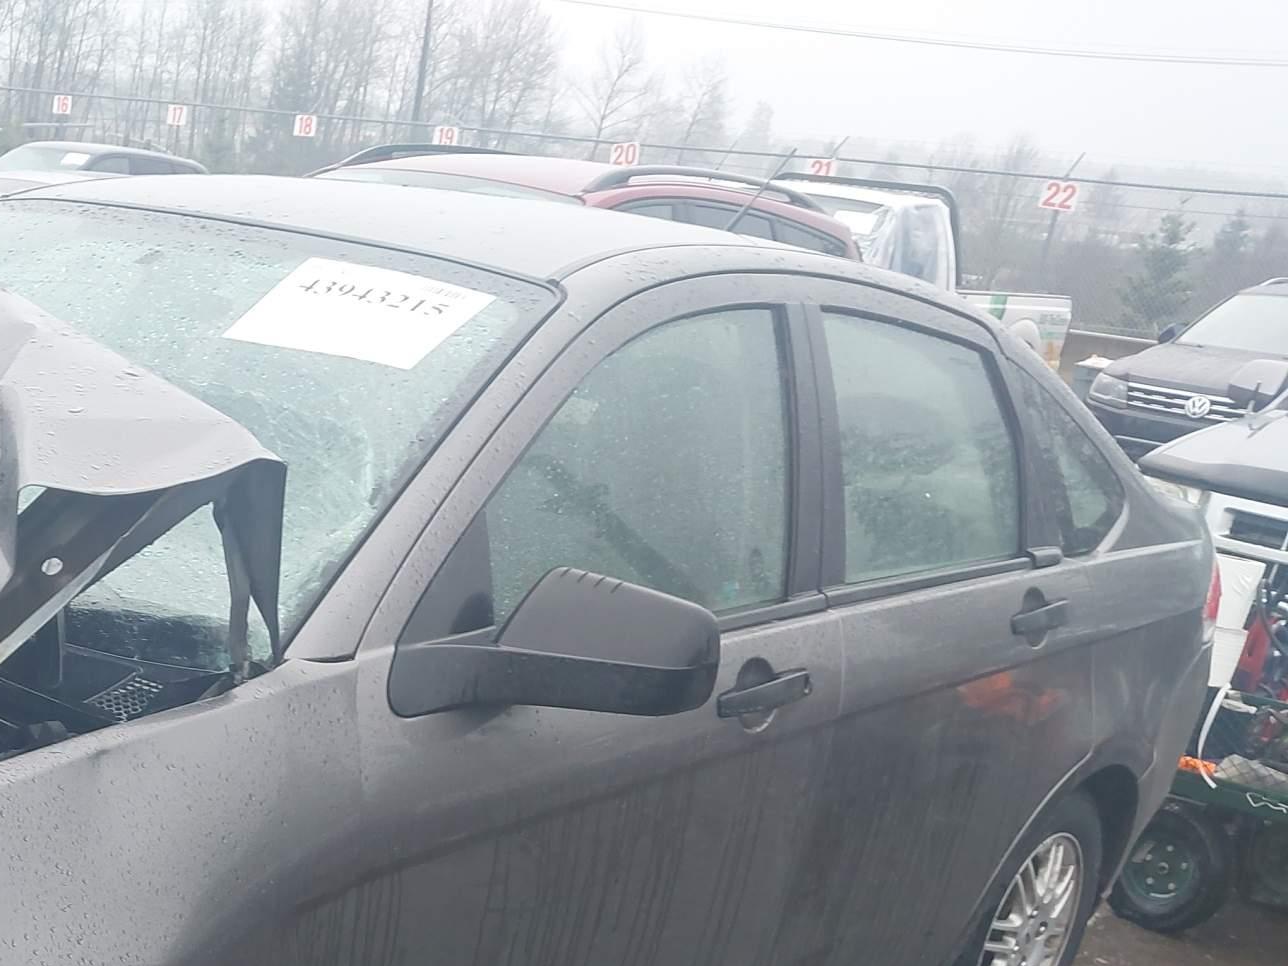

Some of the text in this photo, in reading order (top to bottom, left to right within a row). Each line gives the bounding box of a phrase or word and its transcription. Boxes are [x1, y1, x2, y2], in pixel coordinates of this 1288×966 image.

[56, 96, 68, 113] 16
[170, 106, 183, 124] 17
[298, 117, 313, 135] 18
[439, 127, 455, 145] 19
[614, 143, 637, 166] 20
[811, 160, 832, 177] 21
[1041, 182, 1078, 210] 22
[299, 279, 450, 316] 43943215
